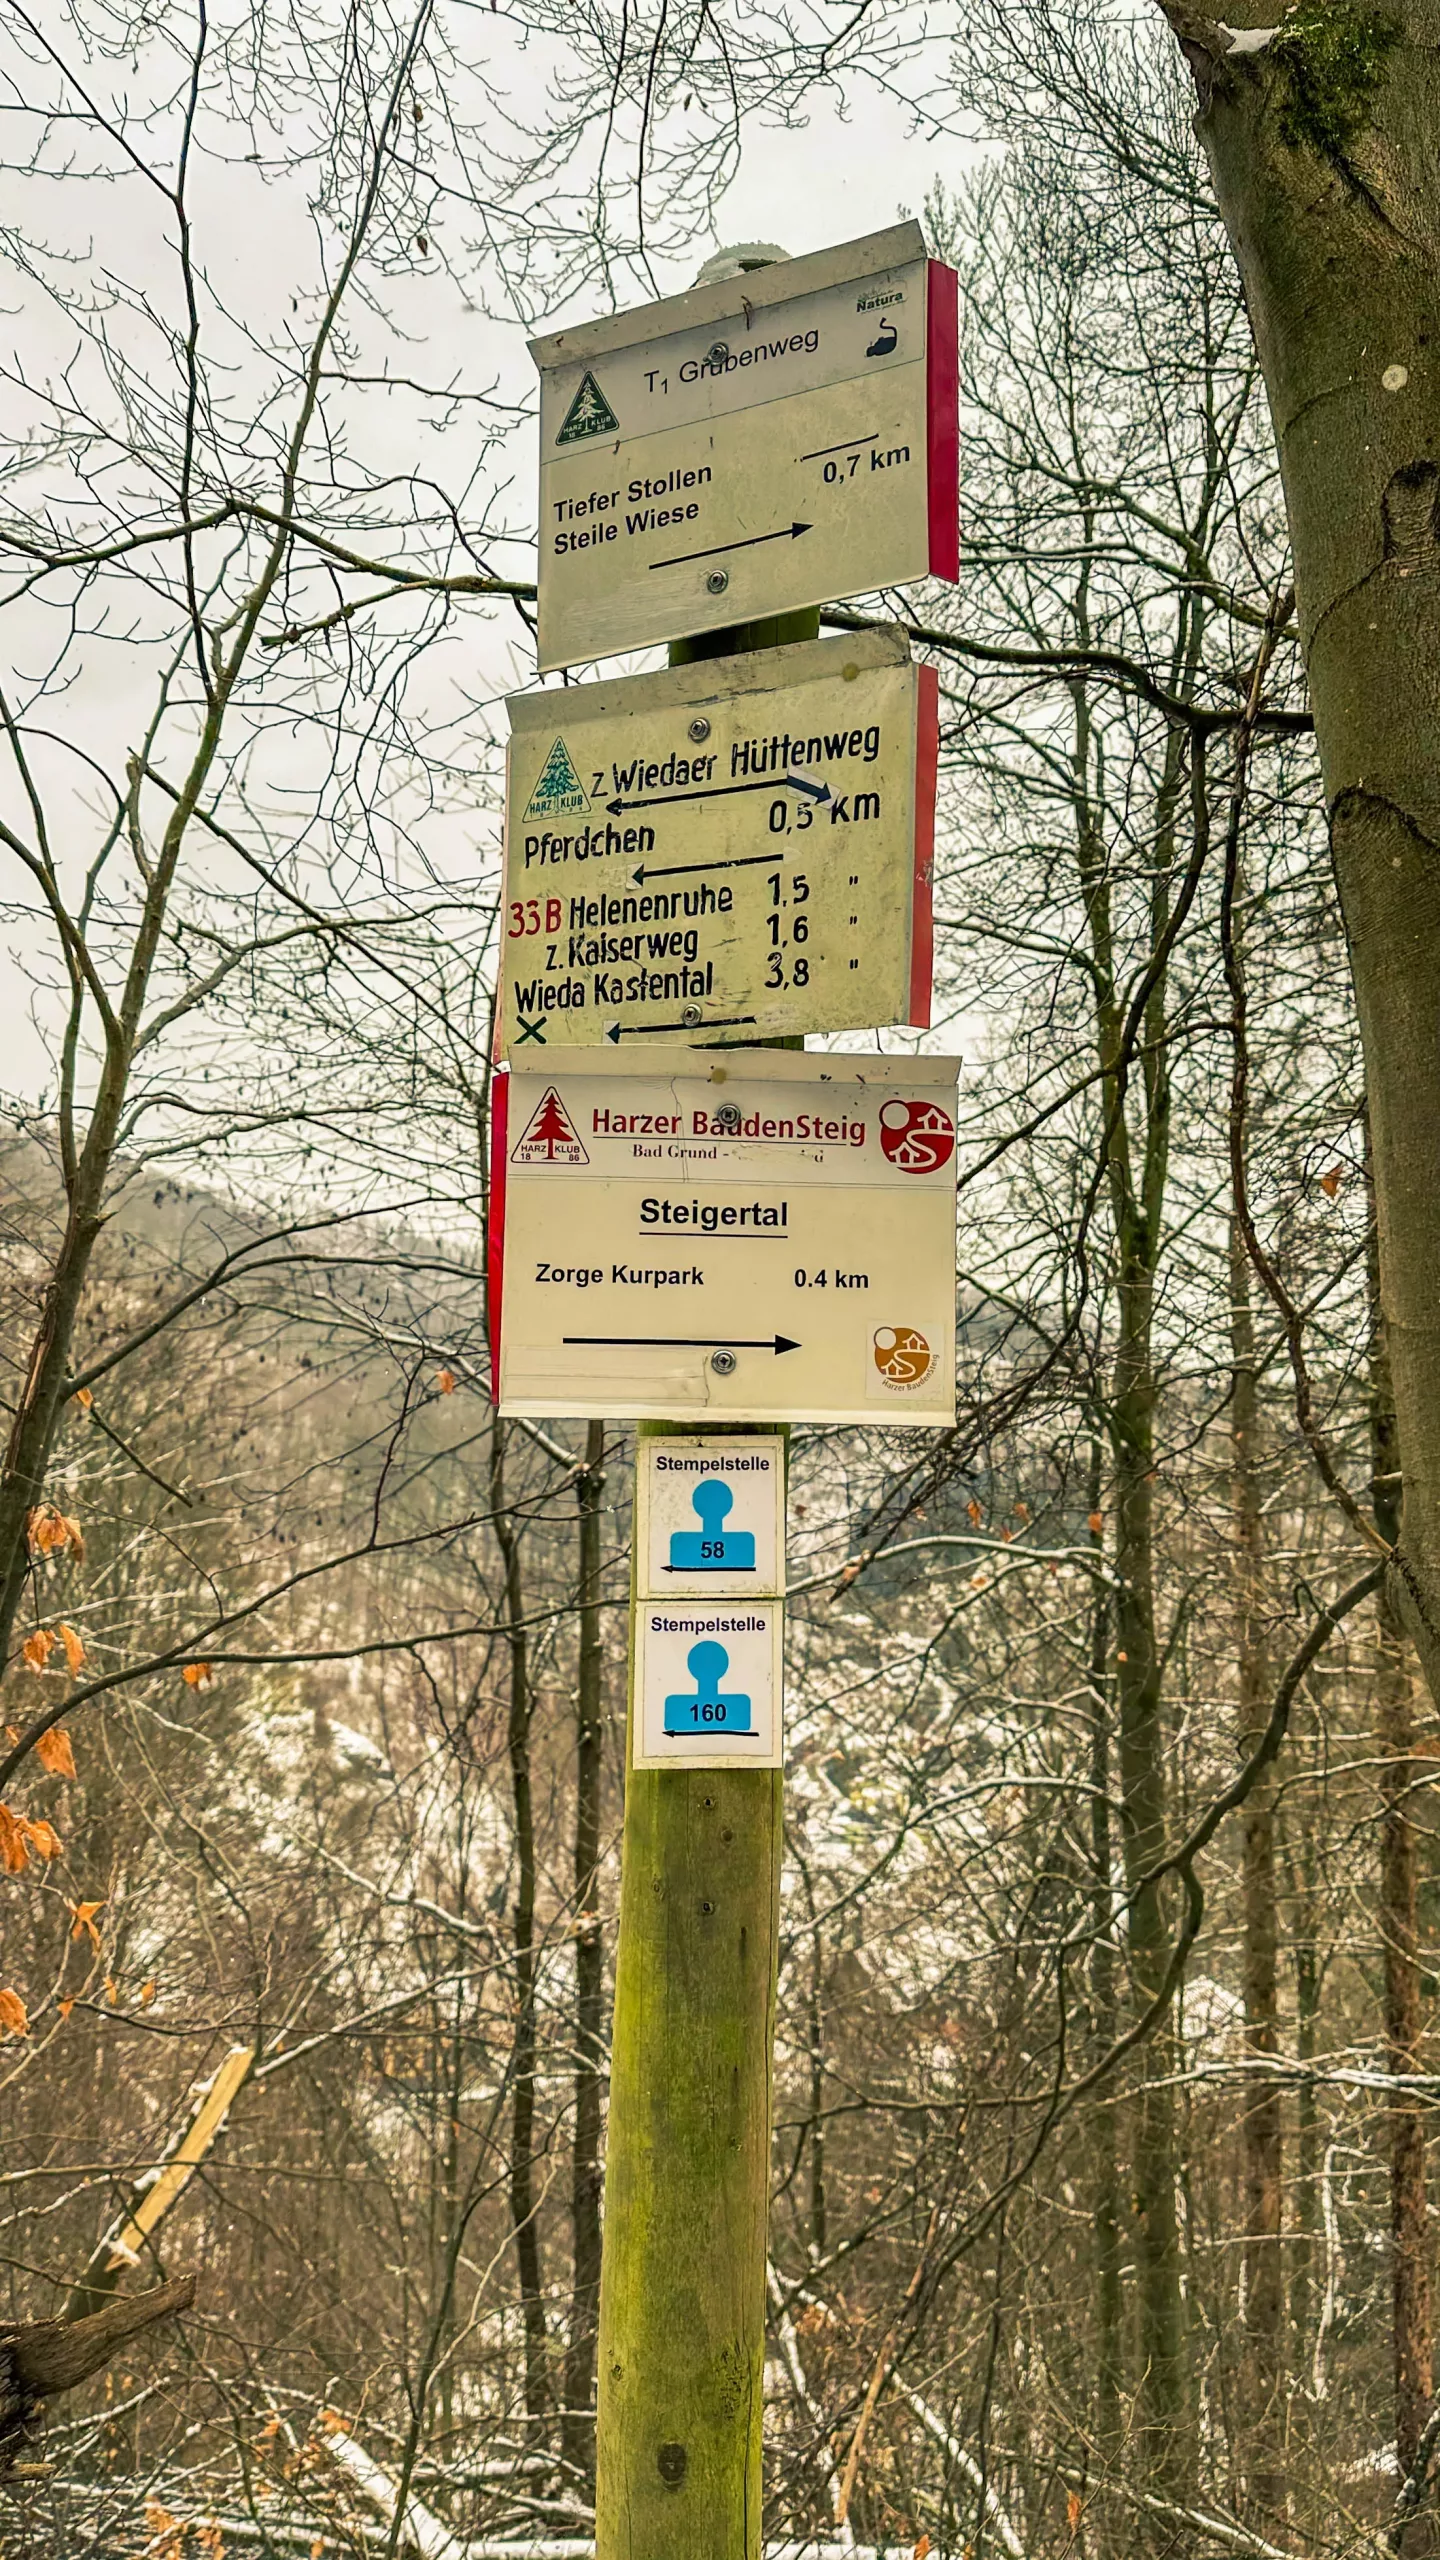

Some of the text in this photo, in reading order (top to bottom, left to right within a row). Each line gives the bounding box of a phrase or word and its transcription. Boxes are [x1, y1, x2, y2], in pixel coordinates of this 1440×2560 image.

[856, 292, 903, 312] Natura
[679, 329, 819, 383] Grubenweg
[591, 416, 611, 426] KLUB
[823, 446, 910, 484] 0,7 km
[553, 466, 712, 522] Tiefer Stollen
[554, 503, 699, 555] Steile Wiese
[612, 751, 718, 794] Wiedaer
[730, 726, 880, 778] Hüttenweg
[529, 795, 583, 813] HARZ KLUB
[525, 822, 655, 869] Pferdchen
[769, 800, 814, 835] 0,5
[569, 883, 733, 930] Helenenruhe
[568, 930, 698, 967] Kaiserweg
[766, 913, 809, 948] 1,6
[514, 976, 585, 1013] Wieda
[594, 961, 713, 1006] Kastental
[764, 952, 810, 991] 3,8
[593, 1109, 865, 1147] Harzer BaudenSteig
[568, 1154, 580, 1162] 86
[633, 1144, 662, 1157] Bad
[667, 1145, 717, 1159] Grund
[640, 1198, 788, 1231] Steigertal
[535, 1264, 868, 1288] Zorge Kurpark 0.4 km
[881, 1354, 940, 1391] Harzer BaudenSteig
[656, 1456, 770, 1474] Stempelstelle
[701, 1541, 725, 1559] 58
[651, 1617, 766, 1635] Stempelstelle
[689, 1703, 727, 1722] 160
